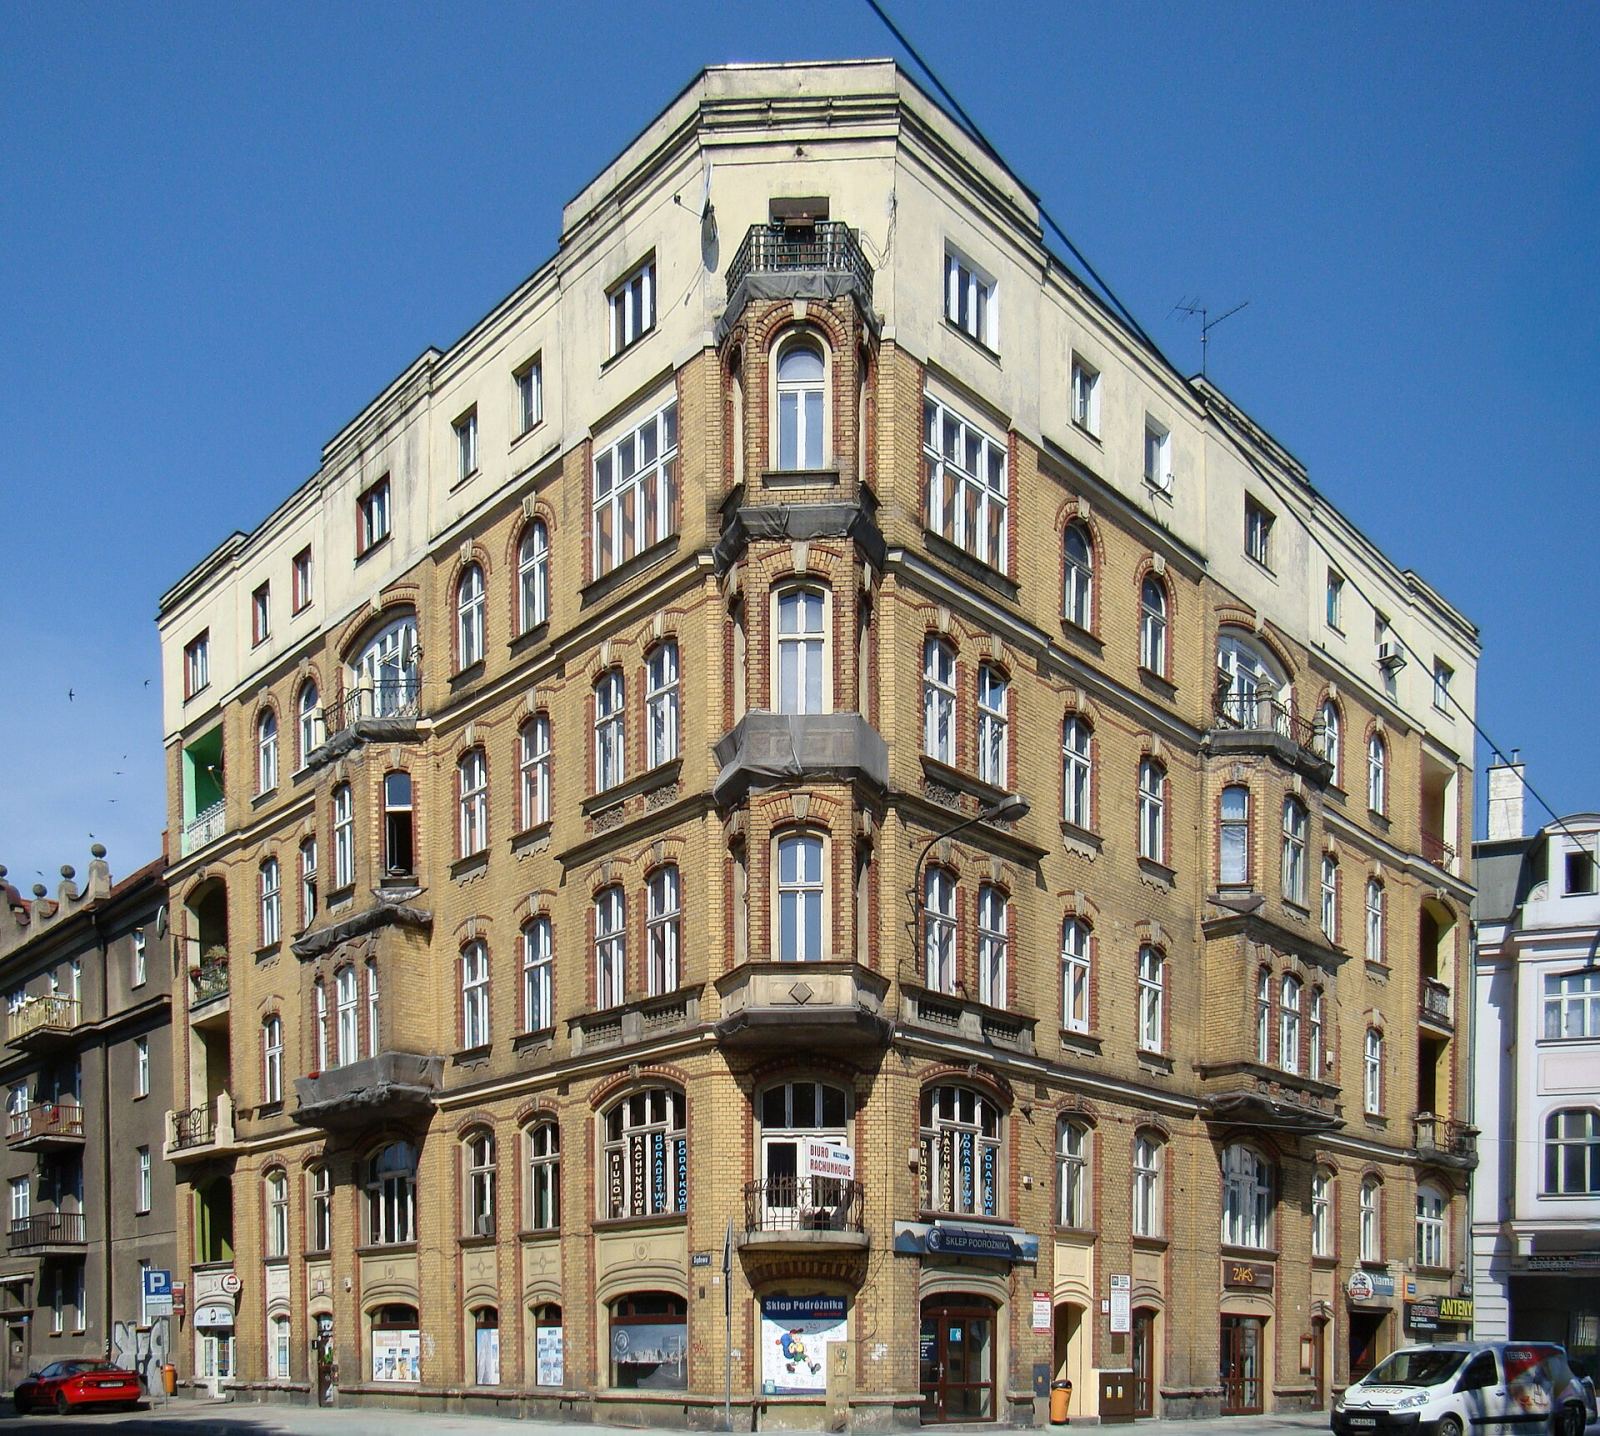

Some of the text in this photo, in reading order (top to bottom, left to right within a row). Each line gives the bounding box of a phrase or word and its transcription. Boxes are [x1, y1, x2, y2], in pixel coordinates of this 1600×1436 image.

[810, 1144, 829, 1159] BIURO
[633, 1136, 643, 1215] RACHUNKOWE
[655, 1134, 663, 1208] DORADZTWO
[678, 1140, 688, 1213] PODATKOWE
[810, 1158, 851, 1177] RACHUNKOWE
[945, 1236, 967, 1247] SKLEP
[766, 1300, 843, 1311] Sklep Podróżnika
[1440, 1298, 1473, 1316] ANTENY
[1506, 1351, 1533, 1361] TERBUD
